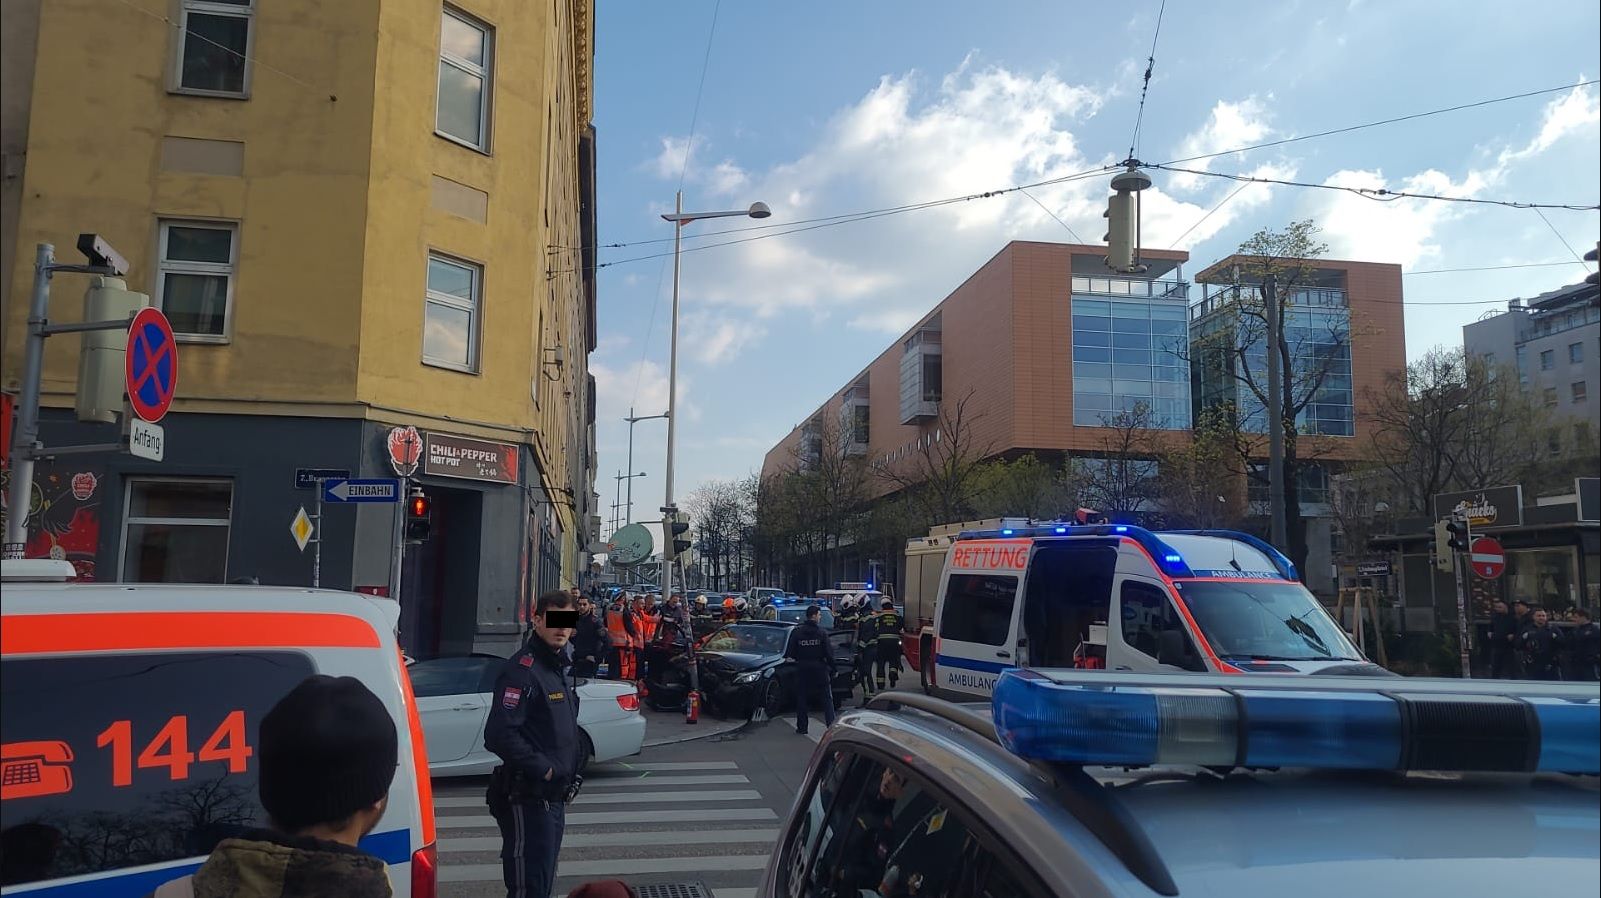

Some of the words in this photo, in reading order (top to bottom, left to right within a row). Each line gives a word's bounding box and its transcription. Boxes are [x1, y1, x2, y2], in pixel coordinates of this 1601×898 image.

[134, 427, 160, 454] Anfang
[431, 444, 456, 457] CHILI
[461, 448, 497, 462] PEPPER
[431, 455, 445, 465] HOT
[446, 457, 460, 466] POT
[348, 485, 391, 496] EINBAHN
[952, 546, 1027, 569] RETTUNG
[948, 673, 998, 690] AMBULANC
[97, 710, 253, 786] 144
